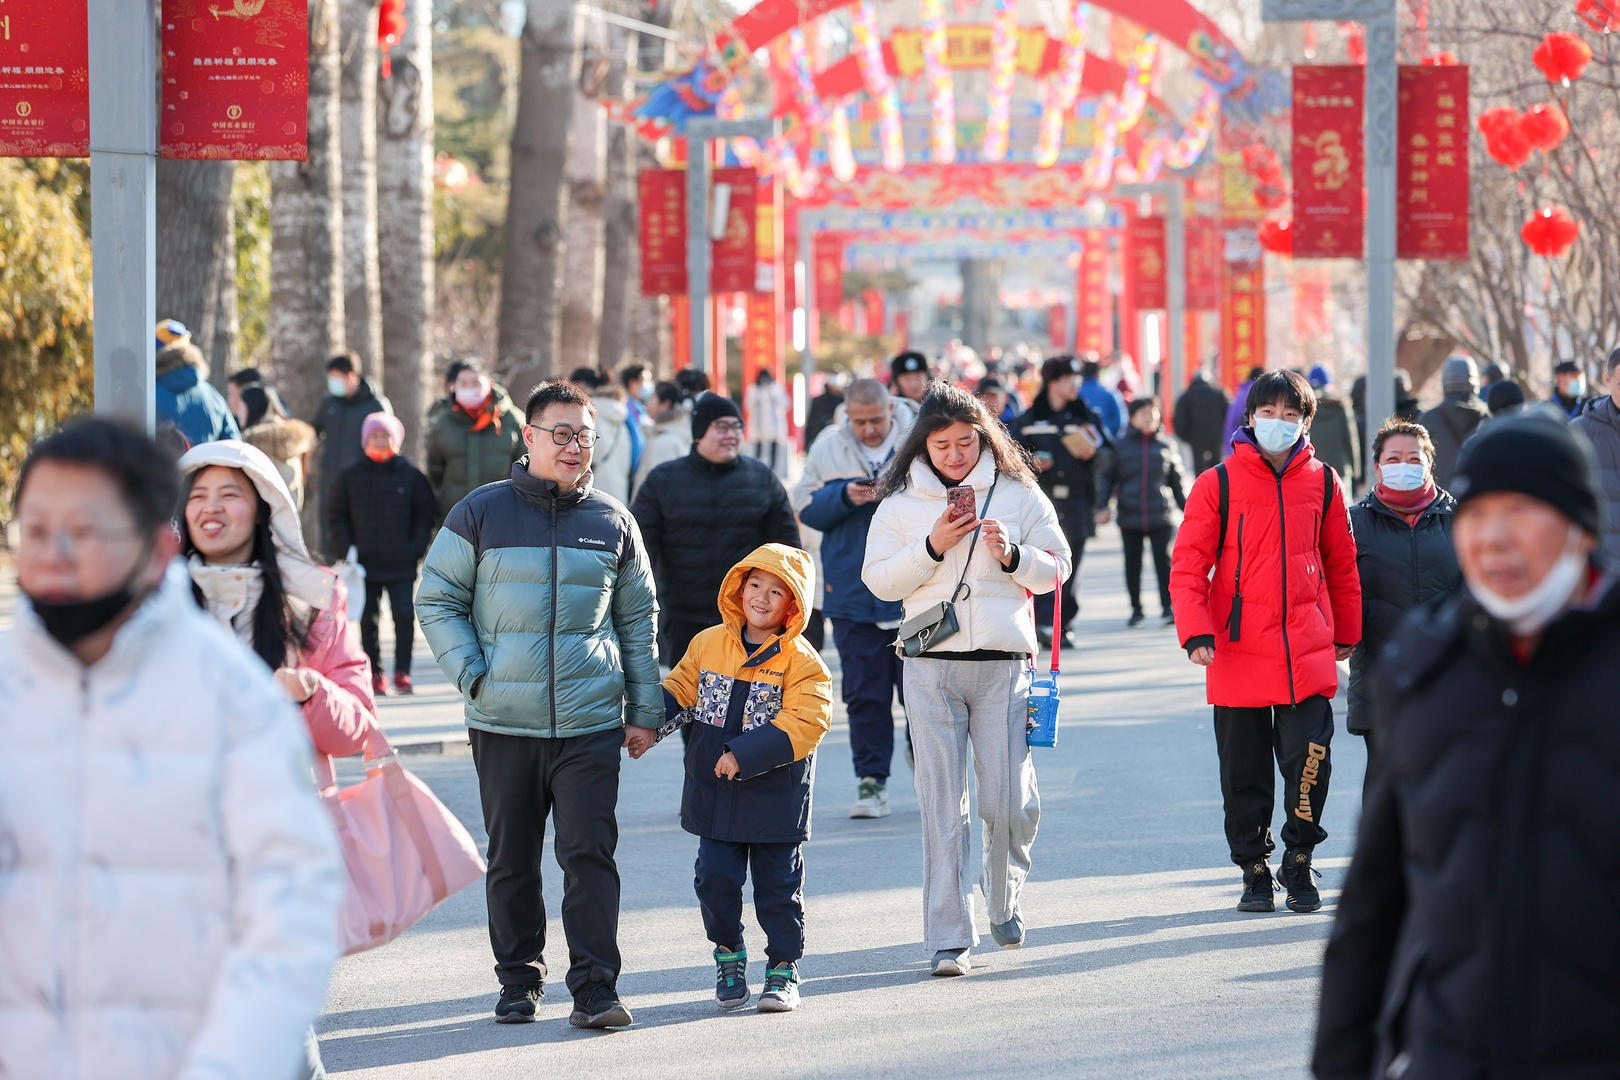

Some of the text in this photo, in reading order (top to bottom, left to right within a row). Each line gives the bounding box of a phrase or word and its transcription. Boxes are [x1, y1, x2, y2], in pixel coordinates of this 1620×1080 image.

[212, 121, 255, 129] 中国农业银行
[583, 537, 606, 546] Columbia
